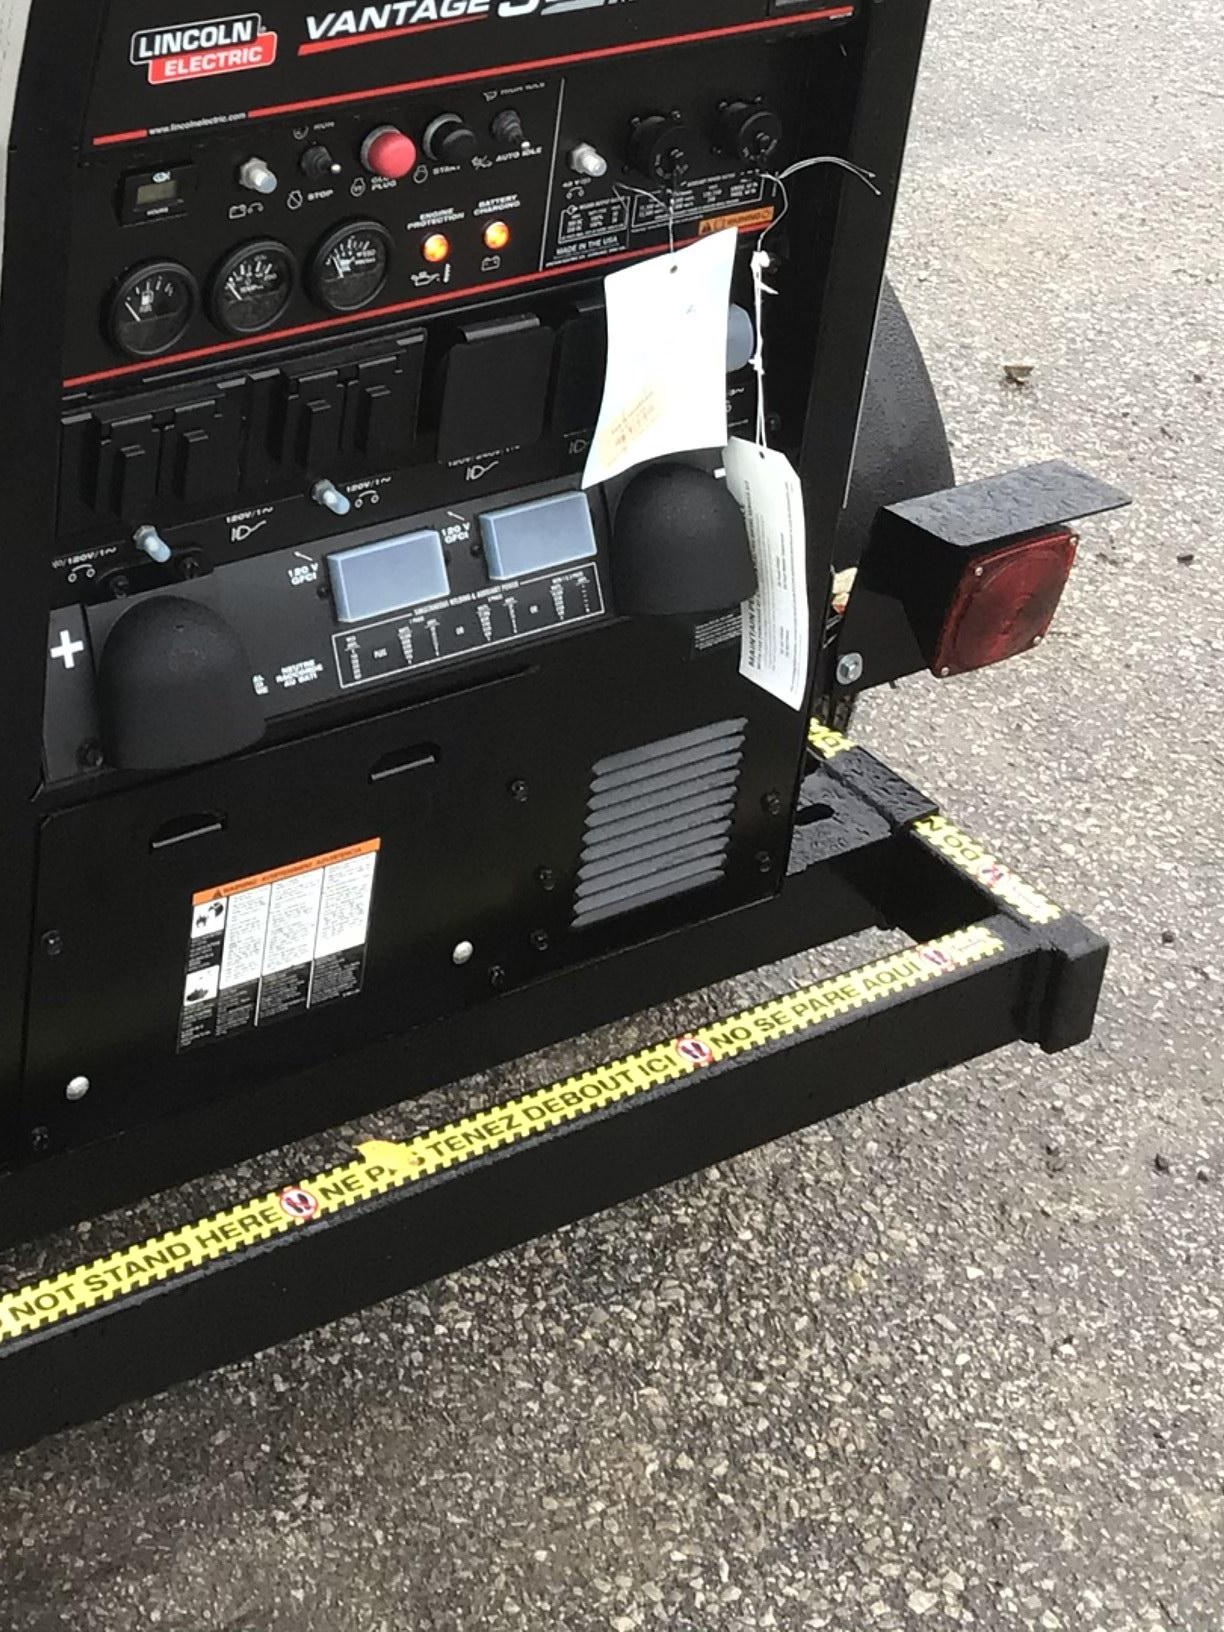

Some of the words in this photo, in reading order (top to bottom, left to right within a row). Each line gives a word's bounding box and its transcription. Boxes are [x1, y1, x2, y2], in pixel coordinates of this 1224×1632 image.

[138, 20, 253, 59] LINCOLN
[164, 46, 264, 78] ELECTRIC
[709, 1025, 752, 1050] NO
[758, 1009, 791, 1034] SE
[792, 982, 862, 1022] PARE
[319, 1174, 364, 1202] NE
[426, 1115, 522, 1159] TENEZ
[524, 1069, 636, 1122] DEBOUT
[638, 1054, 678, 1082] ICI
[7, 1284, 76, 1321] NOT
[83, 1242, 192, 1294] STAND
[195, 1206, 282, 1251] HERE
